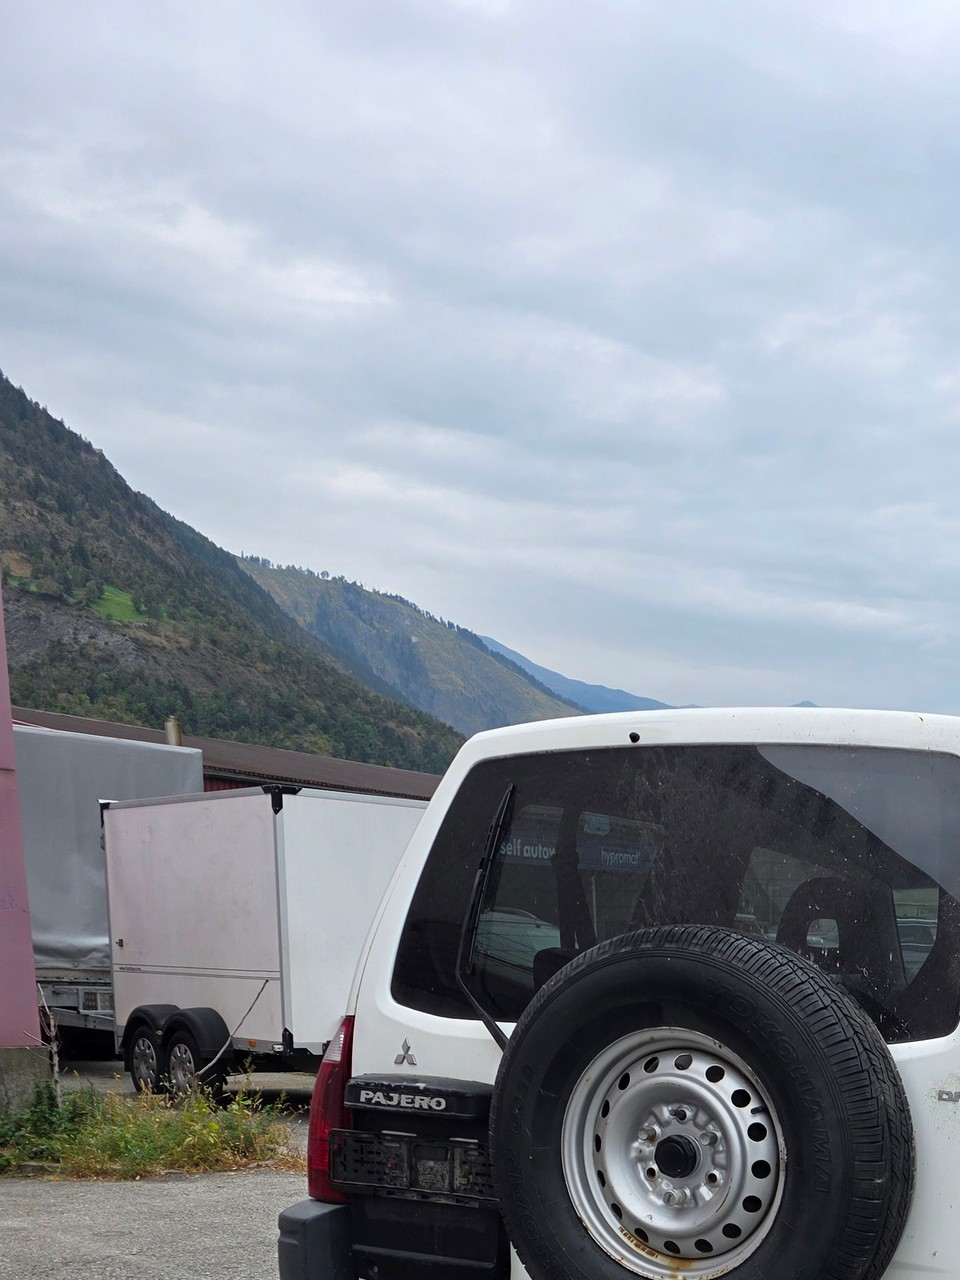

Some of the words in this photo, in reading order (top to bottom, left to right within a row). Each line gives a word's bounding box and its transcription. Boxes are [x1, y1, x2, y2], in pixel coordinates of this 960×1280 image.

[500, 838, 521, 856] self
[707, 976, 832, 1195] YOKOHAMA
[359, 1089, 447, 1111] PAJERO
